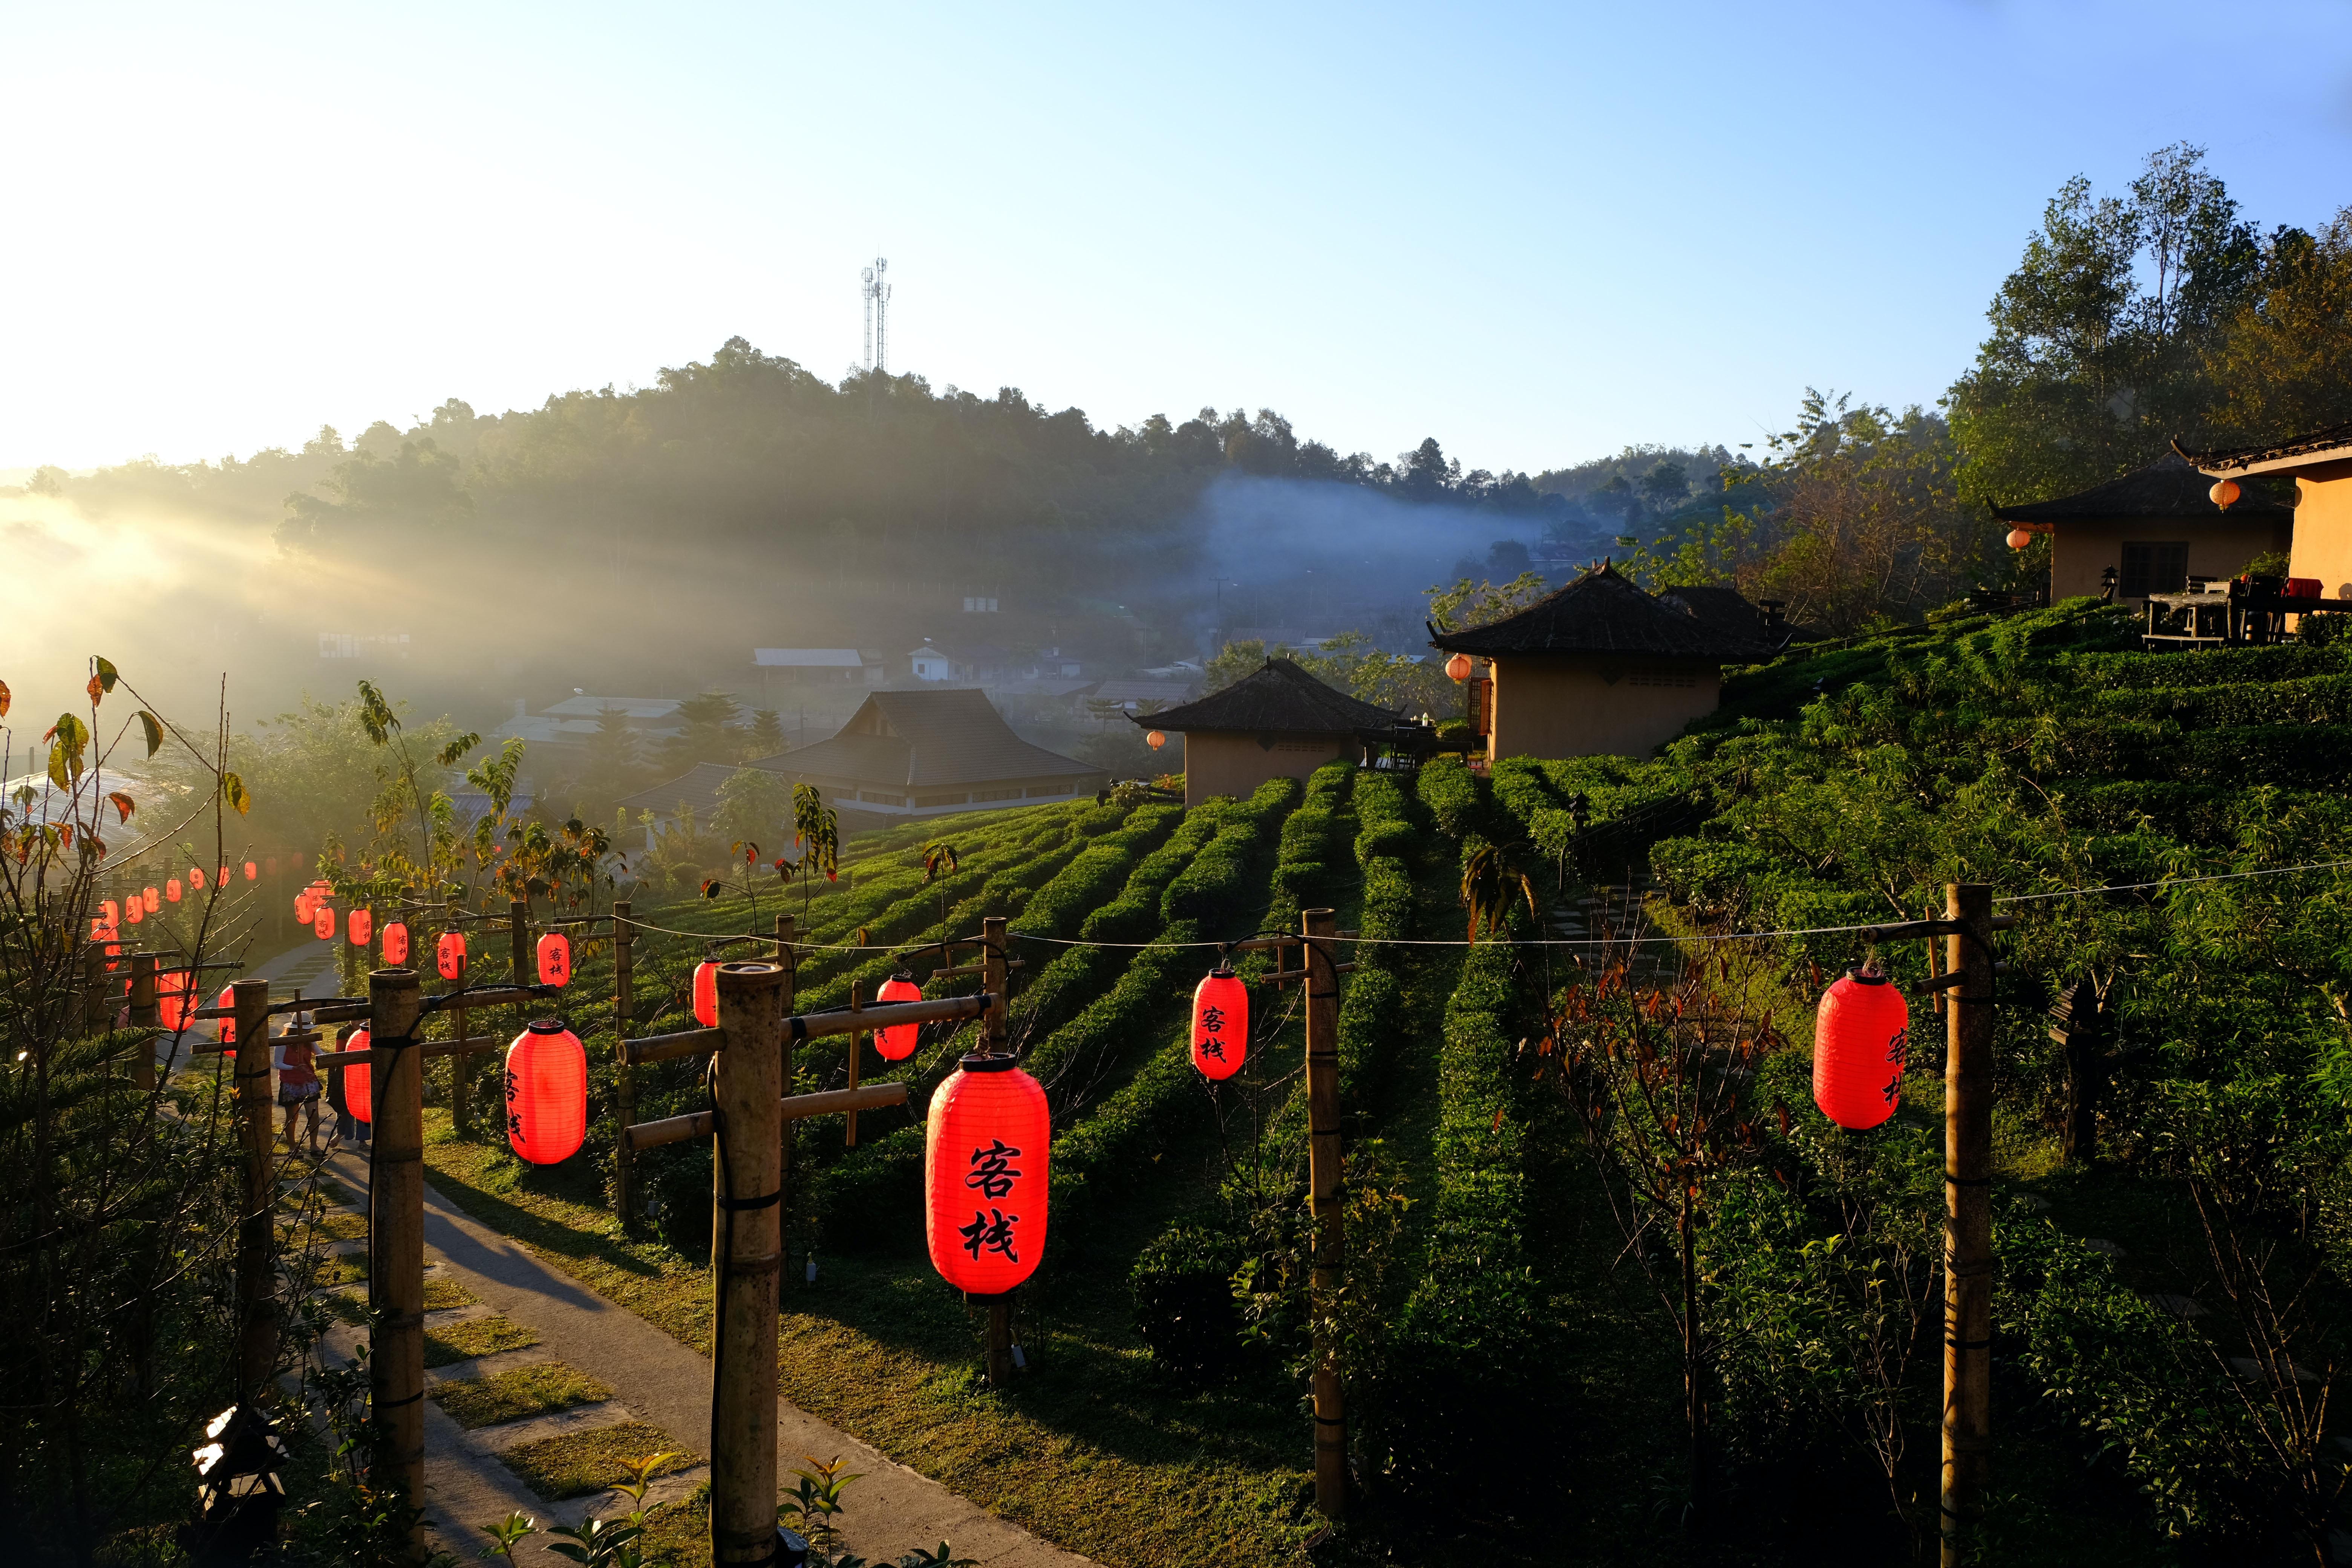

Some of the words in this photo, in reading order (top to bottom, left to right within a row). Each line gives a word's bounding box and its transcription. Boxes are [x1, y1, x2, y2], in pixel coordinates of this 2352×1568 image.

[398, 935, 407, 956] 客栈
[439, 947, 452, 972] 客栈
[548, 947, 564, 976] 客栈
[1200, 1005, 1227, 1064] 客栈
[958, 1139, 1022, 1263] 客栈
